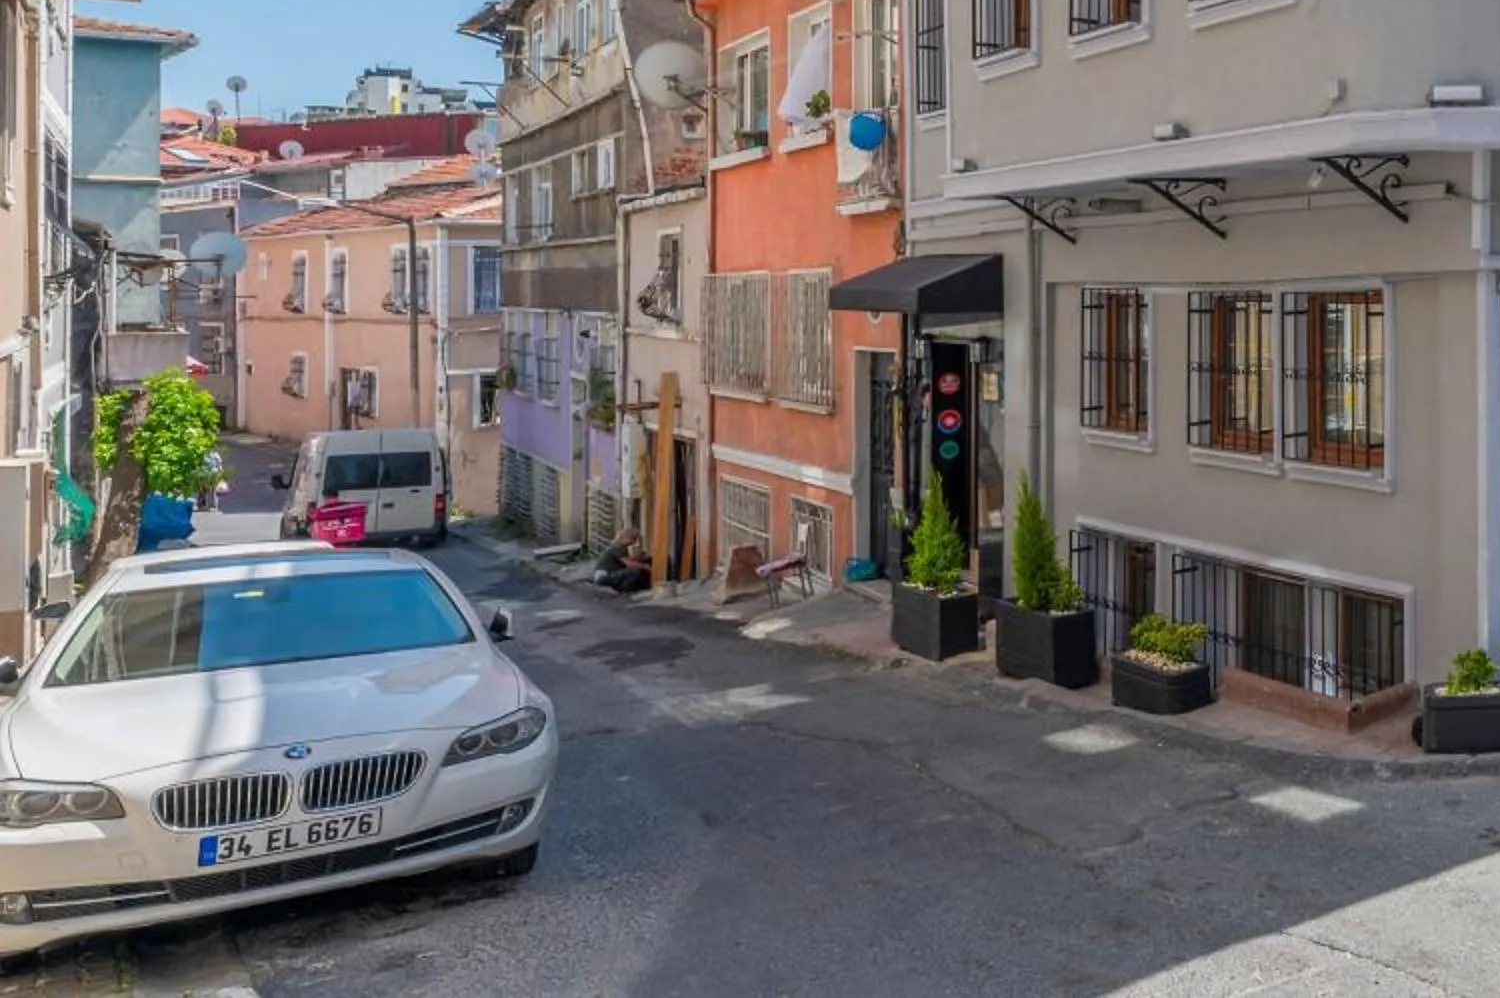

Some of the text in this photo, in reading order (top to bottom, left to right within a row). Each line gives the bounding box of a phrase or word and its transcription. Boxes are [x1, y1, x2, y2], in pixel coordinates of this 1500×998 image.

[219, 813, 373, 859] 34 EL 6676
